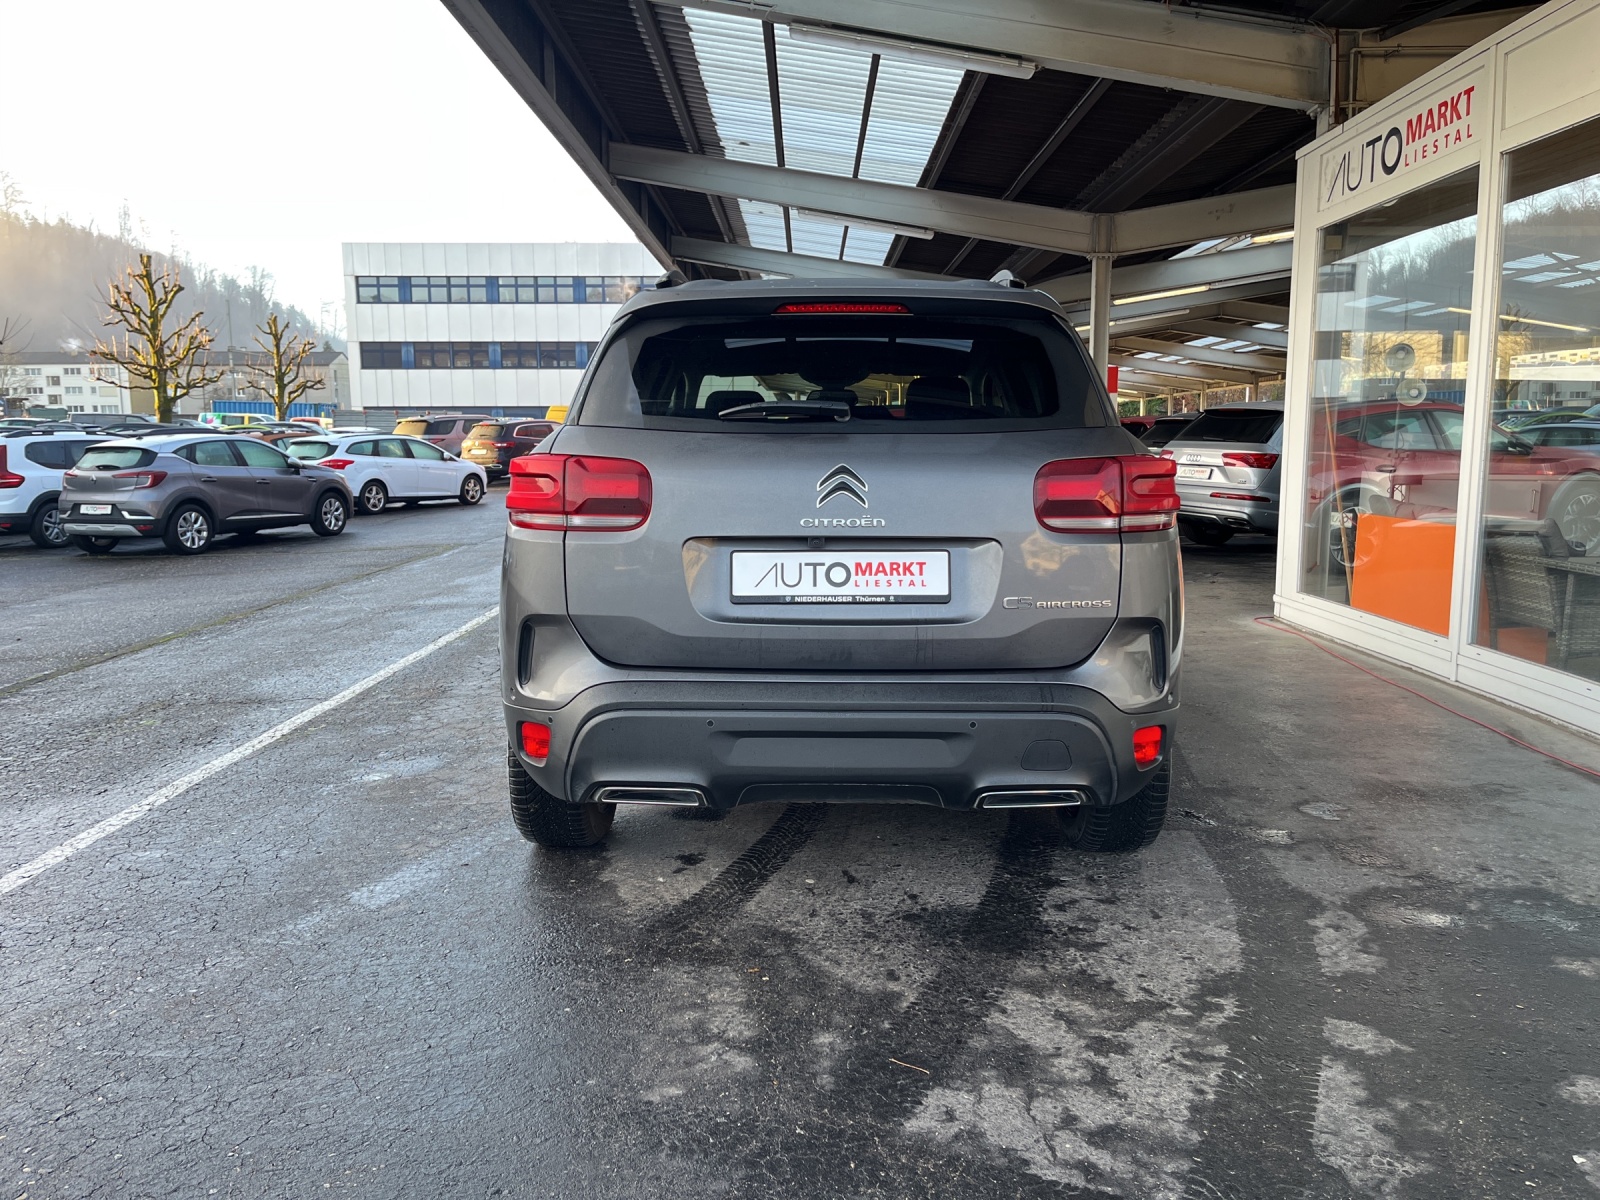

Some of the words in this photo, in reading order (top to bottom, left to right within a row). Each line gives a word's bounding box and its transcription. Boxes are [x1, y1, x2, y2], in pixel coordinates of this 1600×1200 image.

[1327, 126, 1403, 203] AUTO
[1405, 85, 1475, 147] MARKT
[1404, 123, 1473, 168] LIESTAL
[754, 561, 852, 588] AUTO
[854, 561, 927, 577] MARKT
[854, 579, 927, 587] LIESTAL
[1002, 596, 1033, 610] C5
[1036, 599, 1112, 609] AIRCROSS
